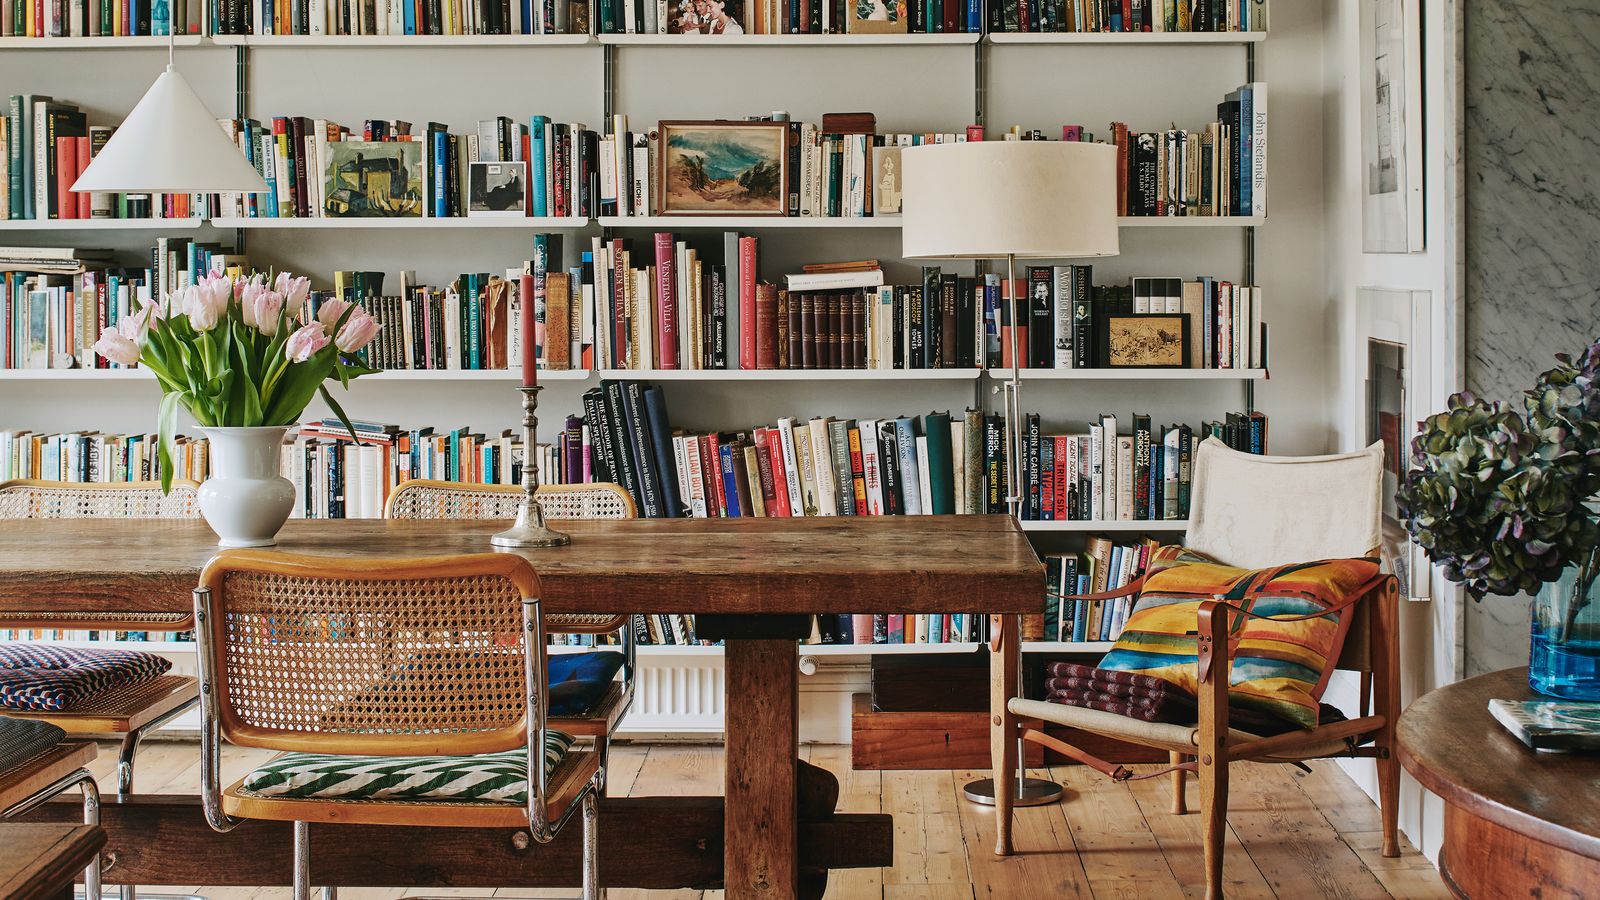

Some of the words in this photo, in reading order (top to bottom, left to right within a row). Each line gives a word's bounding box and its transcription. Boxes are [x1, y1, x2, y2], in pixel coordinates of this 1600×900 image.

[805, 129, 813, 145] TALES
[1255, 111, 1266, 136] John
[805, 145, 813, 160] FROM
[1254, 137, 1266, 189] Stefanidis
[297, 156, 306, 179] TRUTH
[805, 160, 813, 198] SHAKESPEARE
[744, 242, 752, 256] Cecil
[536, 243, 544, 286] GAUGUIN
[662, 259, 671, 302] VENETIAN
[616, 286, 624, 310] VILLA
[1059, 271, 1071, 326] WODEHOUSE
[617, 316, 625, 325] LA
[663, 304, 672, 334] VILLAS
[598, 399, 606, 414] THE
[588, 399, 597, 425] ITALIAN
[594, 425, 604, 461] SPLENDOR
[601, 414, 611, 450] SPLENDOR
[608, 384, 619, 417] Wandmalerei
[616, 427, 628, 467] Frührenaissance
[625, 472, 633, 489] Italien
[628, 384, 639, 417] Wandmalerei
[635, 427, 647, 468] Frührenaissance
[644, 473, 652, 490] Italien
[898, 425, 907, 460] OBLIVION
[904, 434, 912, 449] ACT
[987, 423, 995, 458] HERRON
[89, 441, 98, 467] ZADIE
[687, 439, 700, 475] WILLIAM
[1041, 439, 1049, 471] CUMMING
[1069, 439, 1077, 459] AGENT
[886, 456, 894, 487] ELEMENTS
[990, 469, 998, 488] SECRET
[1031, 456, 1040, 485] CARRÉ
[1057, 463, 1065, 498] TRINITY
[1069, 460, 1077, 482] ZIGZAG
[691, 477, 703, 498] BOYD
[990, 488, 998, 505] HOURS
[1041, 471, 1053, 511] TYPHOON
[1057, 498, 1065, 514] SIX
